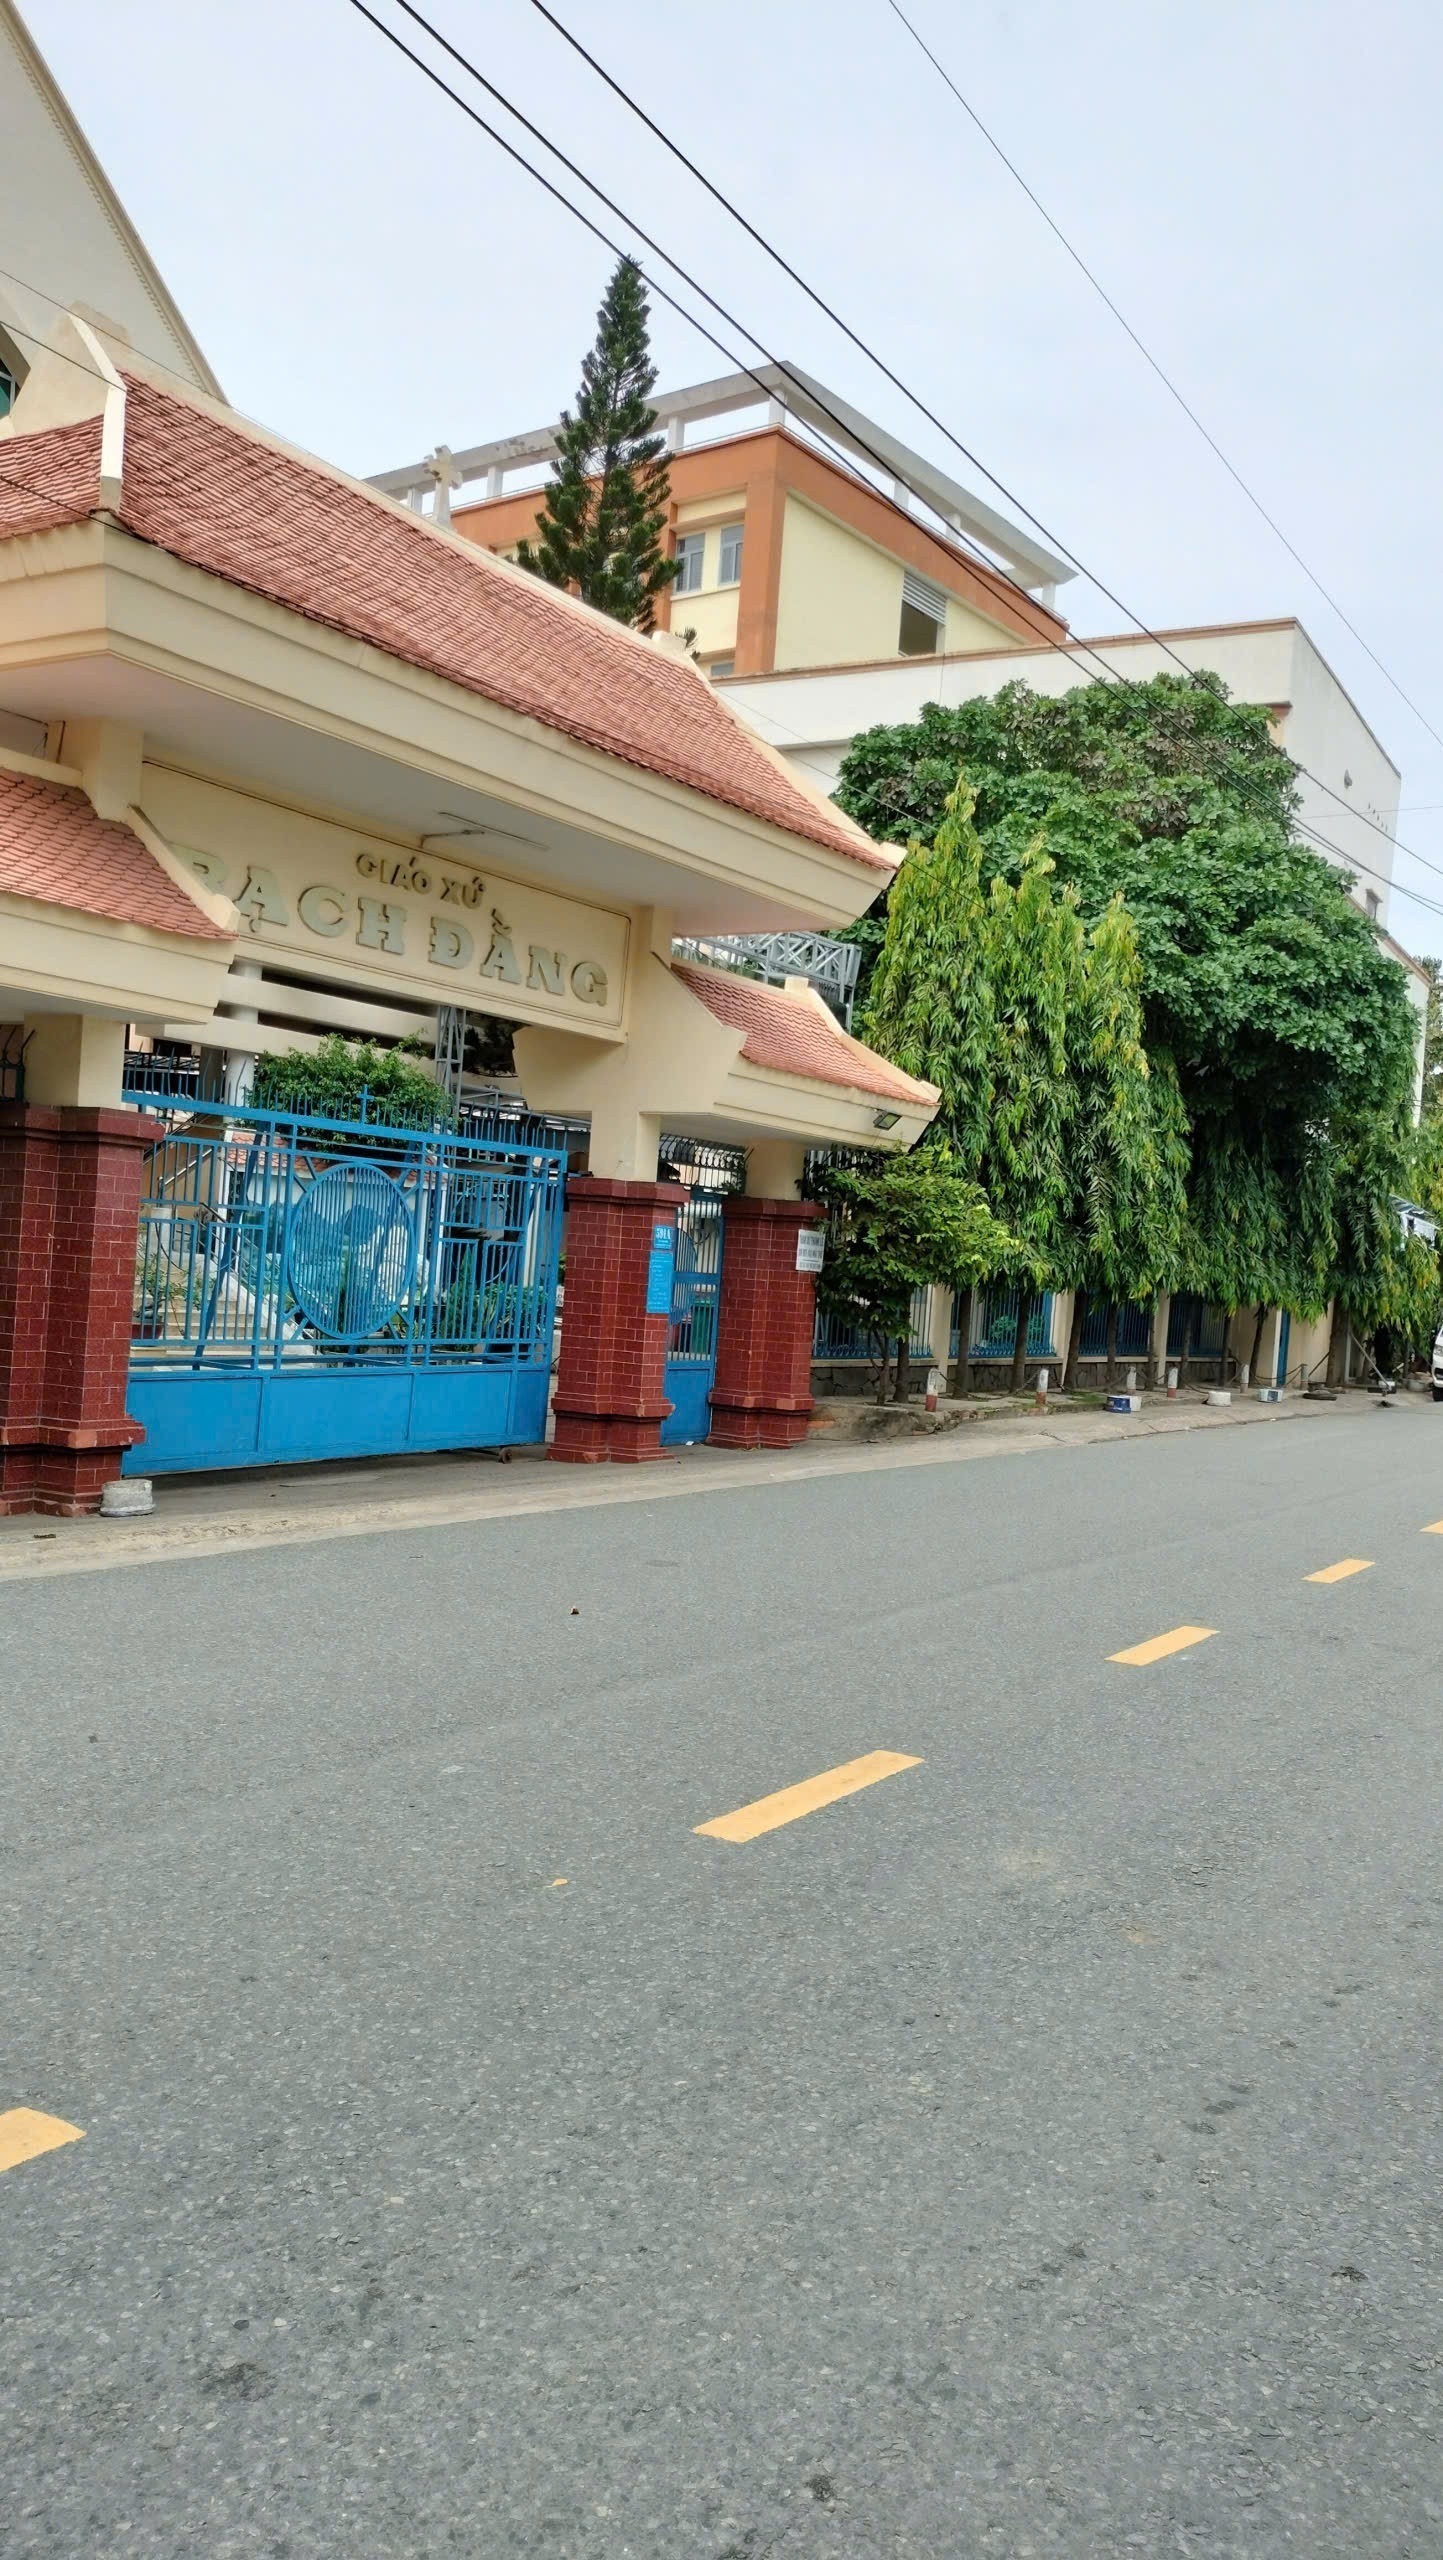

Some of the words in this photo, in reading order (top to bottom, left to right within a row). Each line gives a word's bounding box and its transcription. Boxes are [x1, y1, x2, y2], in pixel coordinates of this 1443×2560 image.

[356, 853, 431, 894] GIÁO
[440, 876, 486, 909] XỨ
[427, 908, 608, 1007] ĐẰNG
